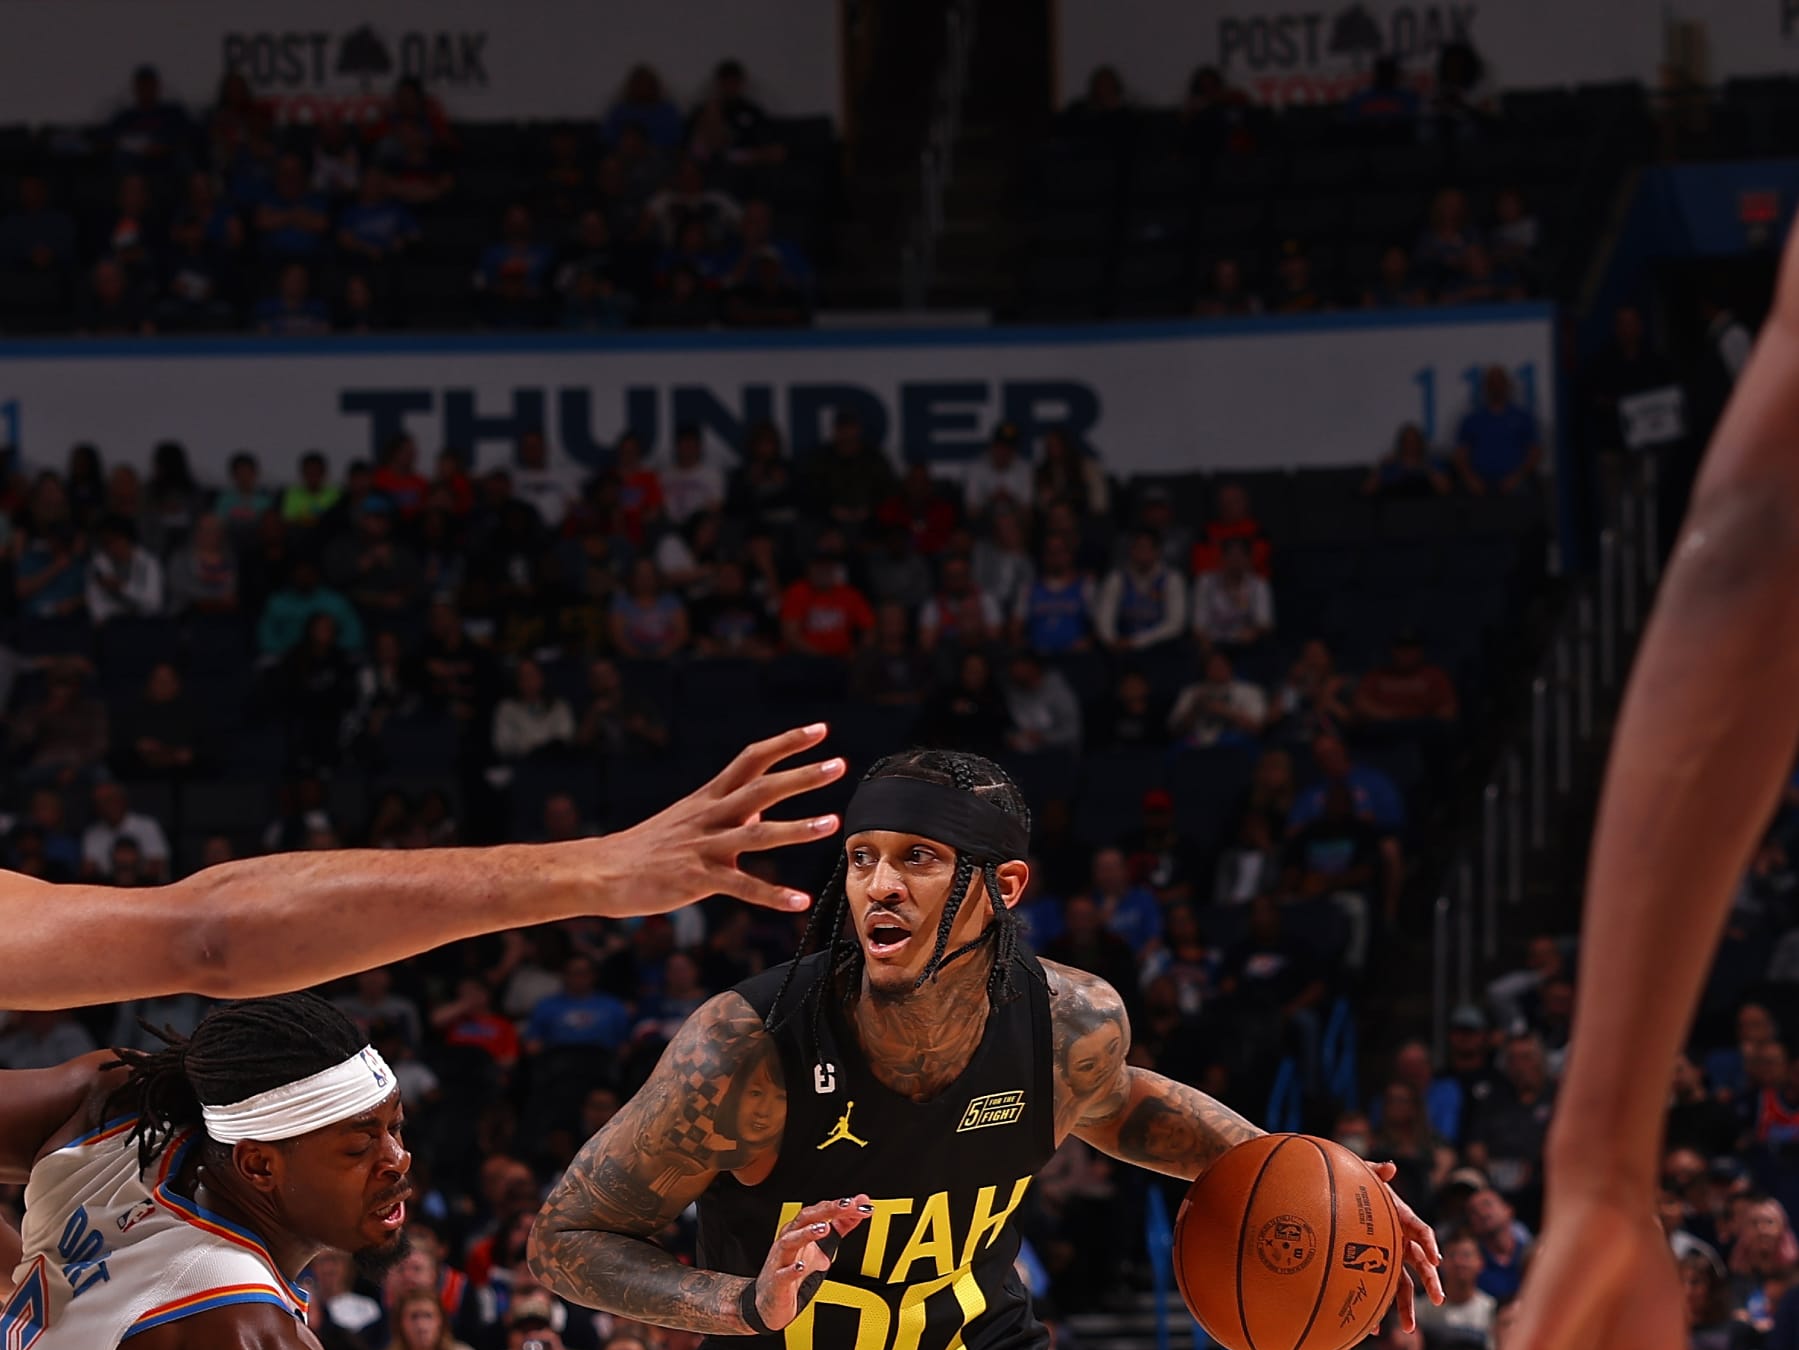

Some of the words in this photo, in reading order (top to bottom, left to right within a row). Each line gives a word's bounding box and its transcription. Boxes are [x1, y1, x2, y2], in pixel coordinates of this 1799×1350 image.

[222, 32, 329, 87] POST
[400, 32, 490, 87] OAK
[1219, 13, 1322, 69] POST
[340, 380, 1103, 468] THUNDER
[964, 1101, 983, 1127] 5
[981, 1107, 1018, 1123] FIGHT
